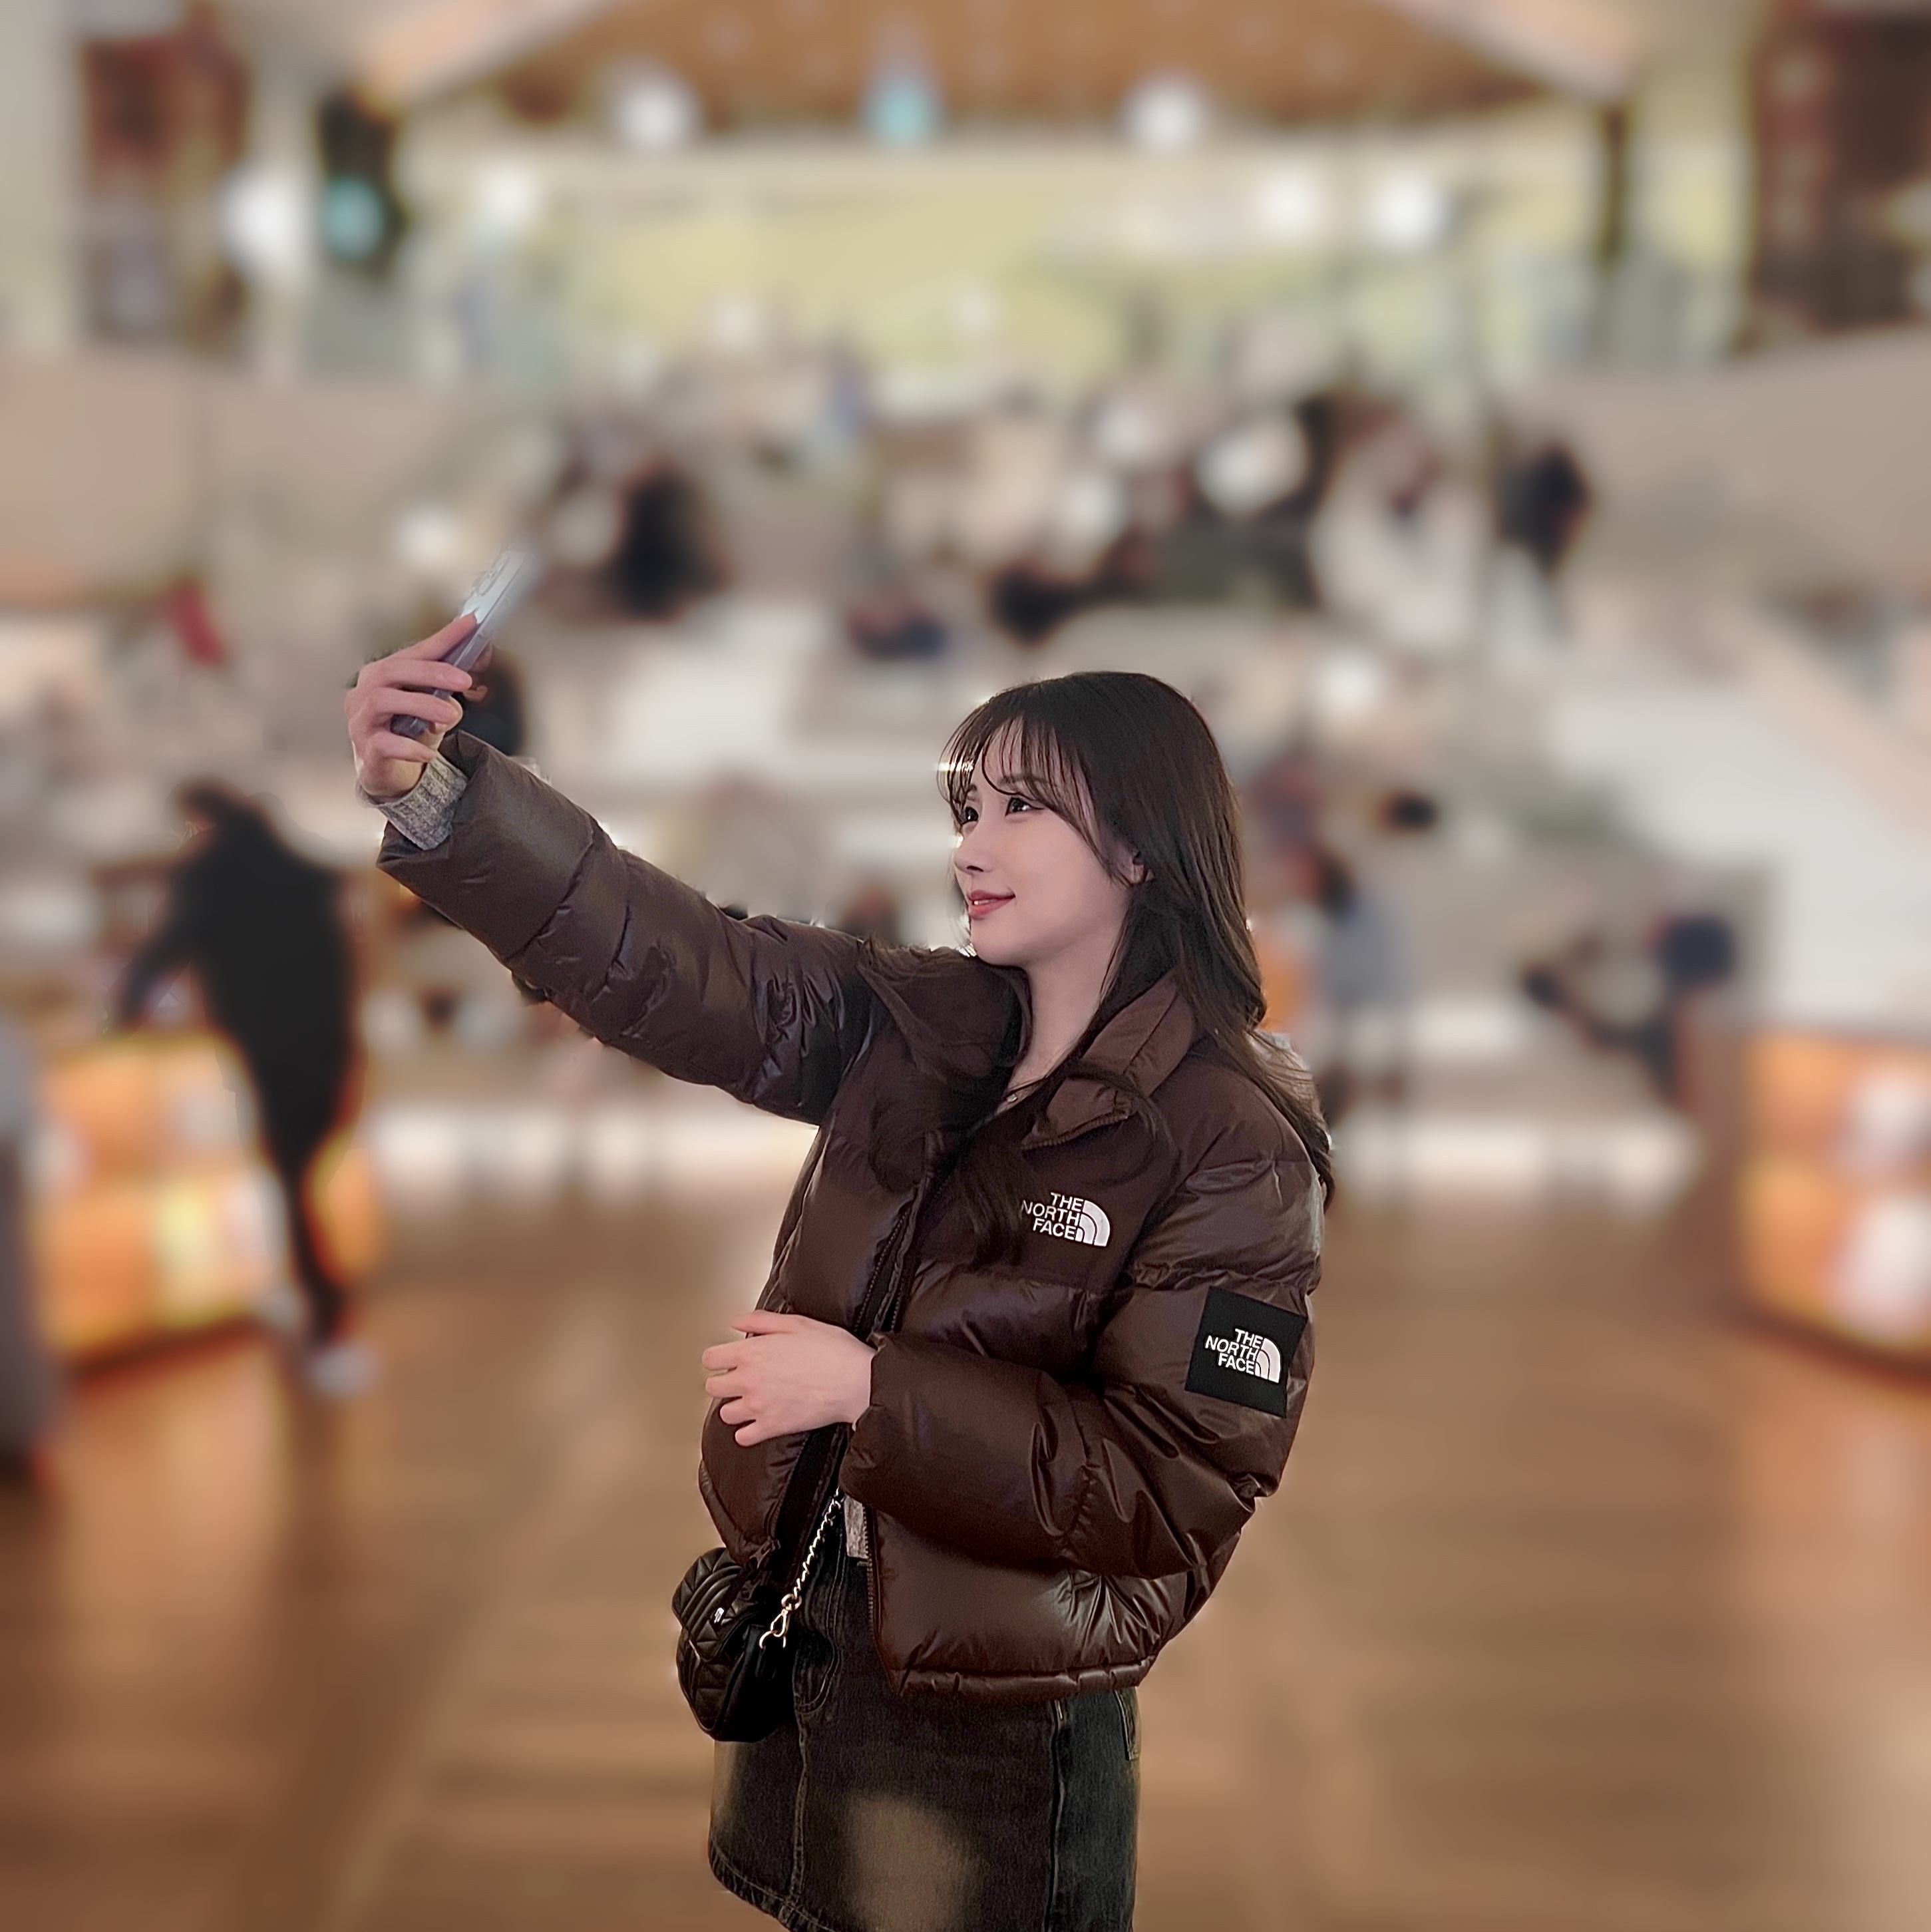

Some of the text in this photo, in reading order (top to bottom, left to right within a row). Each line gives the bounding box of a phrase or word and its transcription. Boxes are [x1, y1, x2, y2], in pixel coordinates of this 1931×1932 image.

[1020, 1200, 1080, 1226] NORTH
[1050, 1192, 1084, 1212] THE
[1033, 1218, 1076, 1241] FACE
[1205, 1335, 1259, 1361] NORTH
[1235, 1328, 1263, 1349] THE
[1218, 1352, 1256, 1375] FACE
